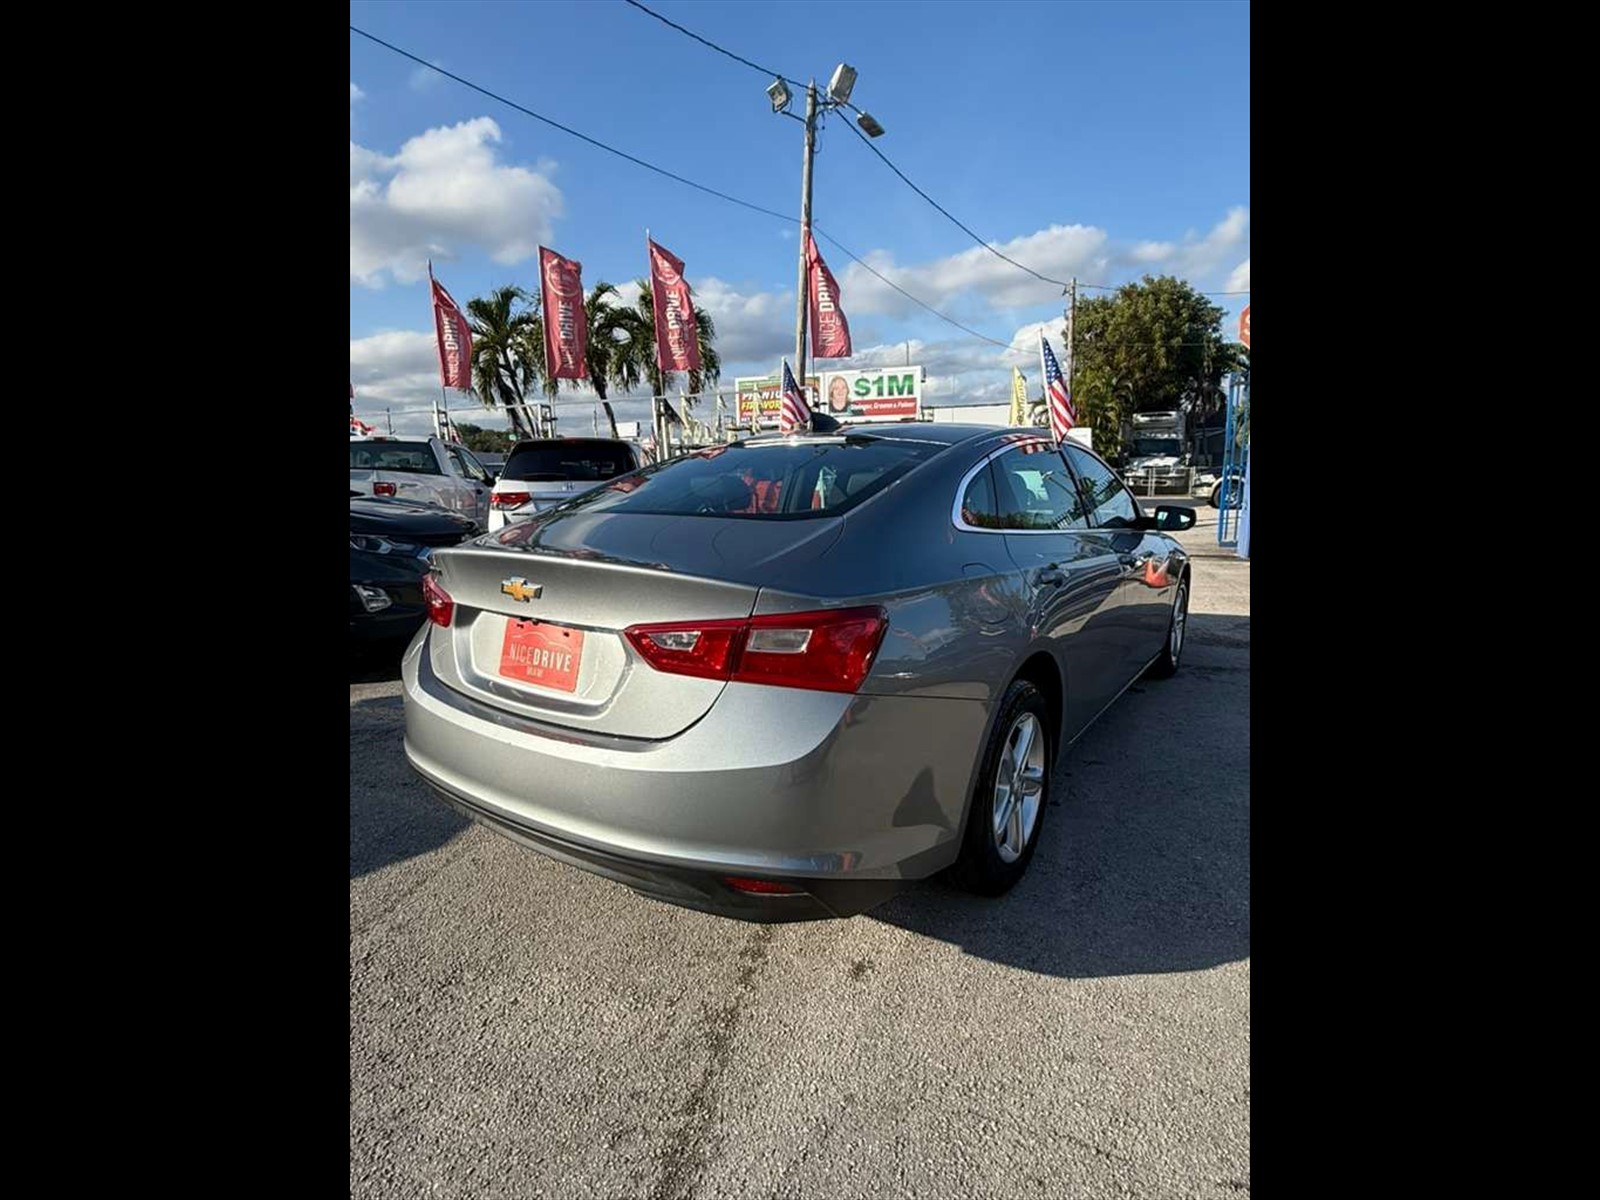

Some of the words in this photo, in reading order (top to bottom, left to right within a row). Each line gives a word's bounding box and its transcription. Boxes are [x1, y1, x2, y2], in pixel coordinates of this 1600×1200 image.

[558, 300, 574, 339] DRIVE
[665, 290, 682, 329] DRIVE
[667, 331, 684, 360] NICE
[818, 315, 836, 346] NICE
[854, 374, 915, 397] $1M
